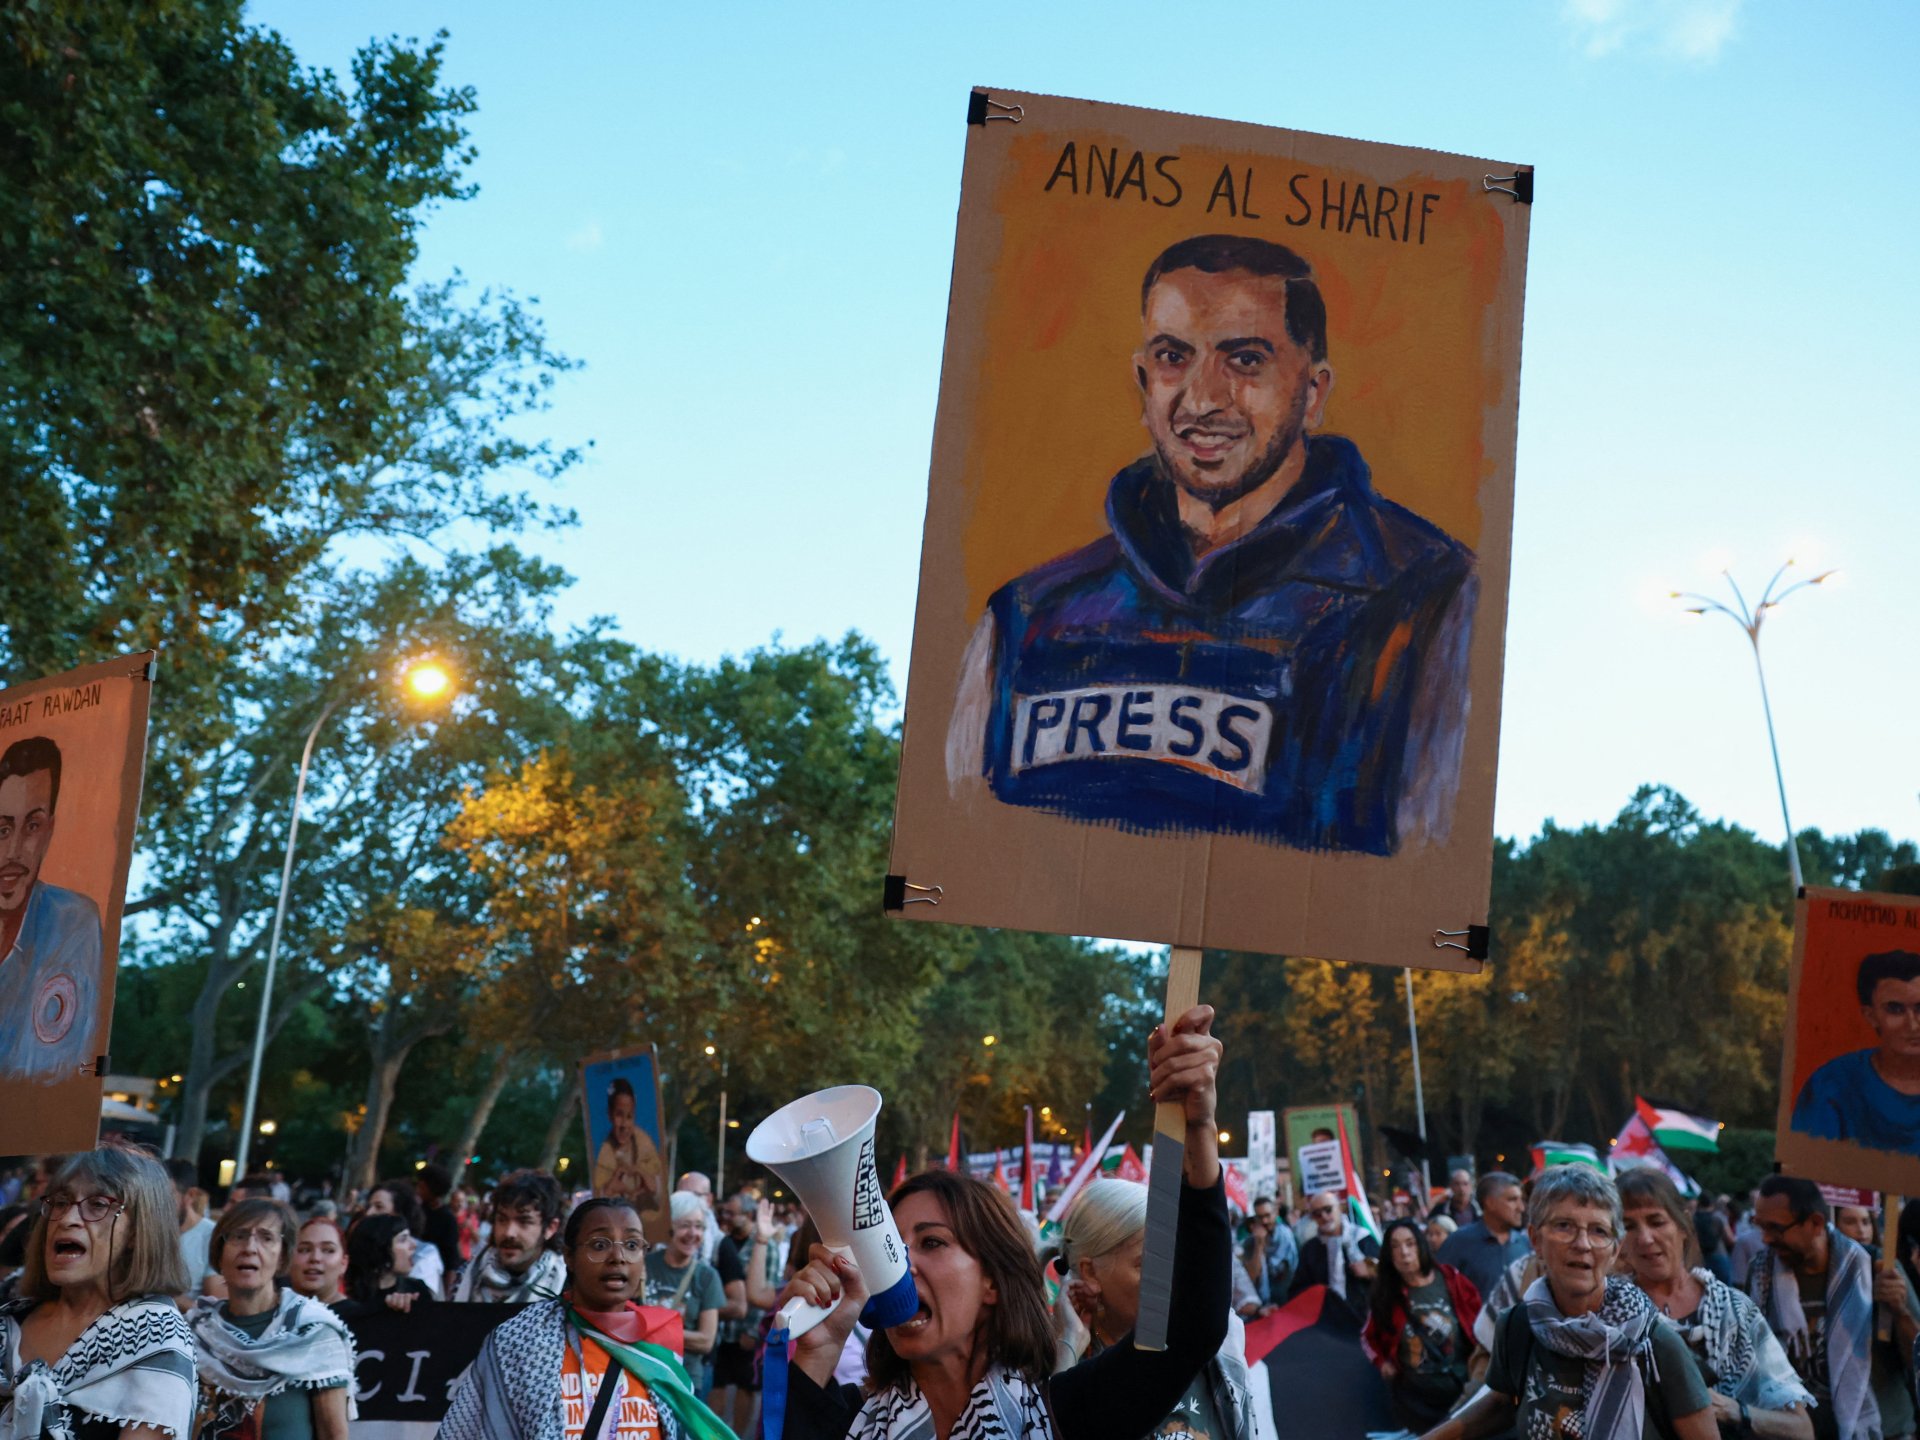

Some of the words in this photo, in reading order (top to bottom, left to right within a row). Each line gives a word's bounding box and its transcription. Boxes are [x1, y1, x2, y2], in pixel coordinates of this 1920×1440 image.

[1044, 141, 1182, 207] ANAS
[1206, 164, 1260, 219] AL
[1285, 174, 1440, 245] SHARIF
[42, 683, 102, 719] RAWDAN
[1022, 691, 1260, 771] PRESS
[855, 1142, 871, 1230] WELCOME
